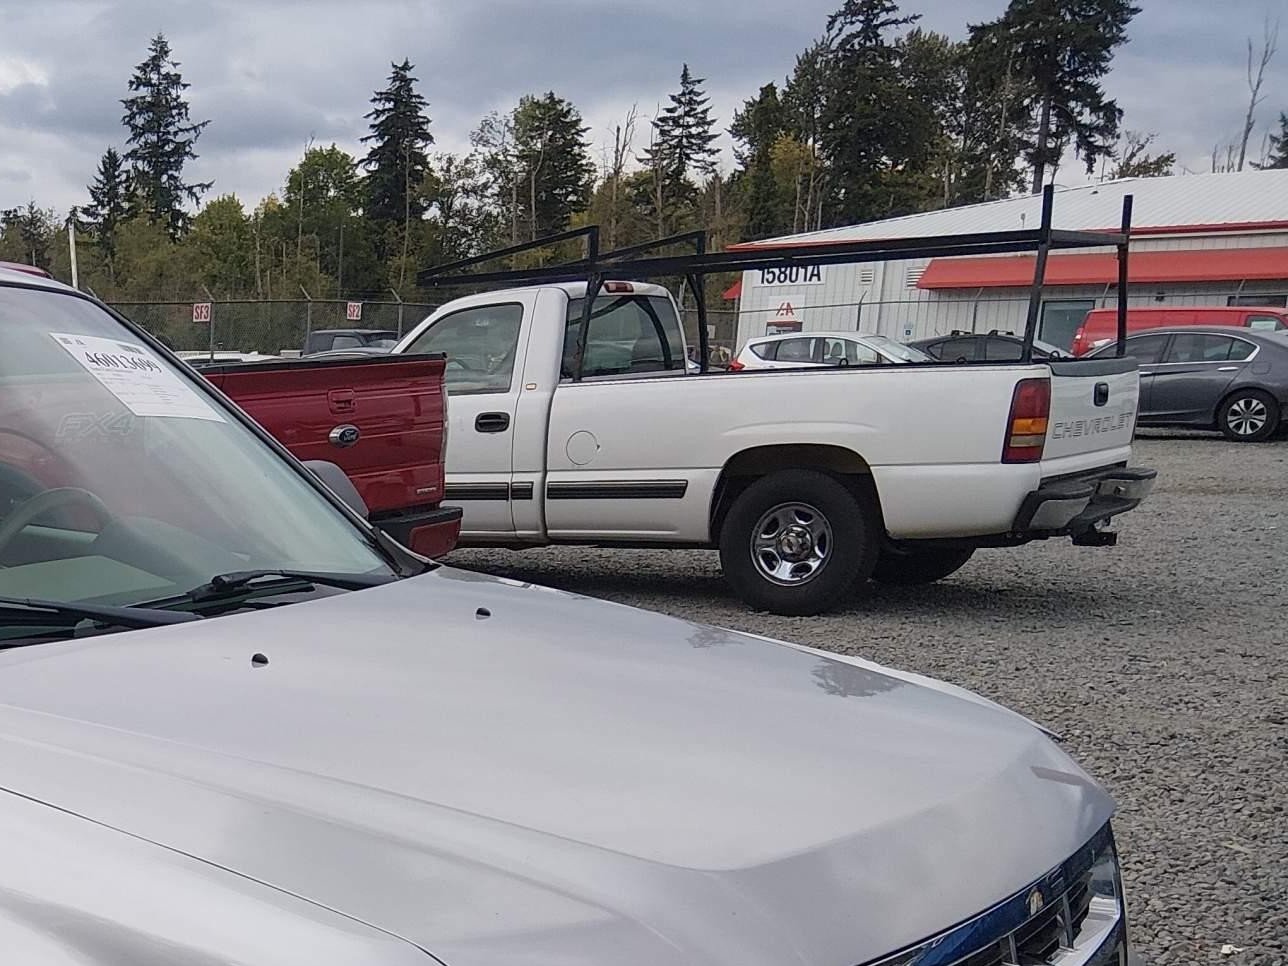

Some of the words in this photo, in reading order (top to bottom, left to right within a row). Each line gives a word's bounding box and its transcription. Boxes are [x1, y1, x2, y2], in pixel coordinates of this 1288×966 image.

[194, 304, 210, 320] SF3
[348, 304, 361, 319] SF2
[84, 351, 163, 373] 46013699
[56, 412, 138, 438] FX4
[1052, 412, 1133, 439] CHEVROLET
